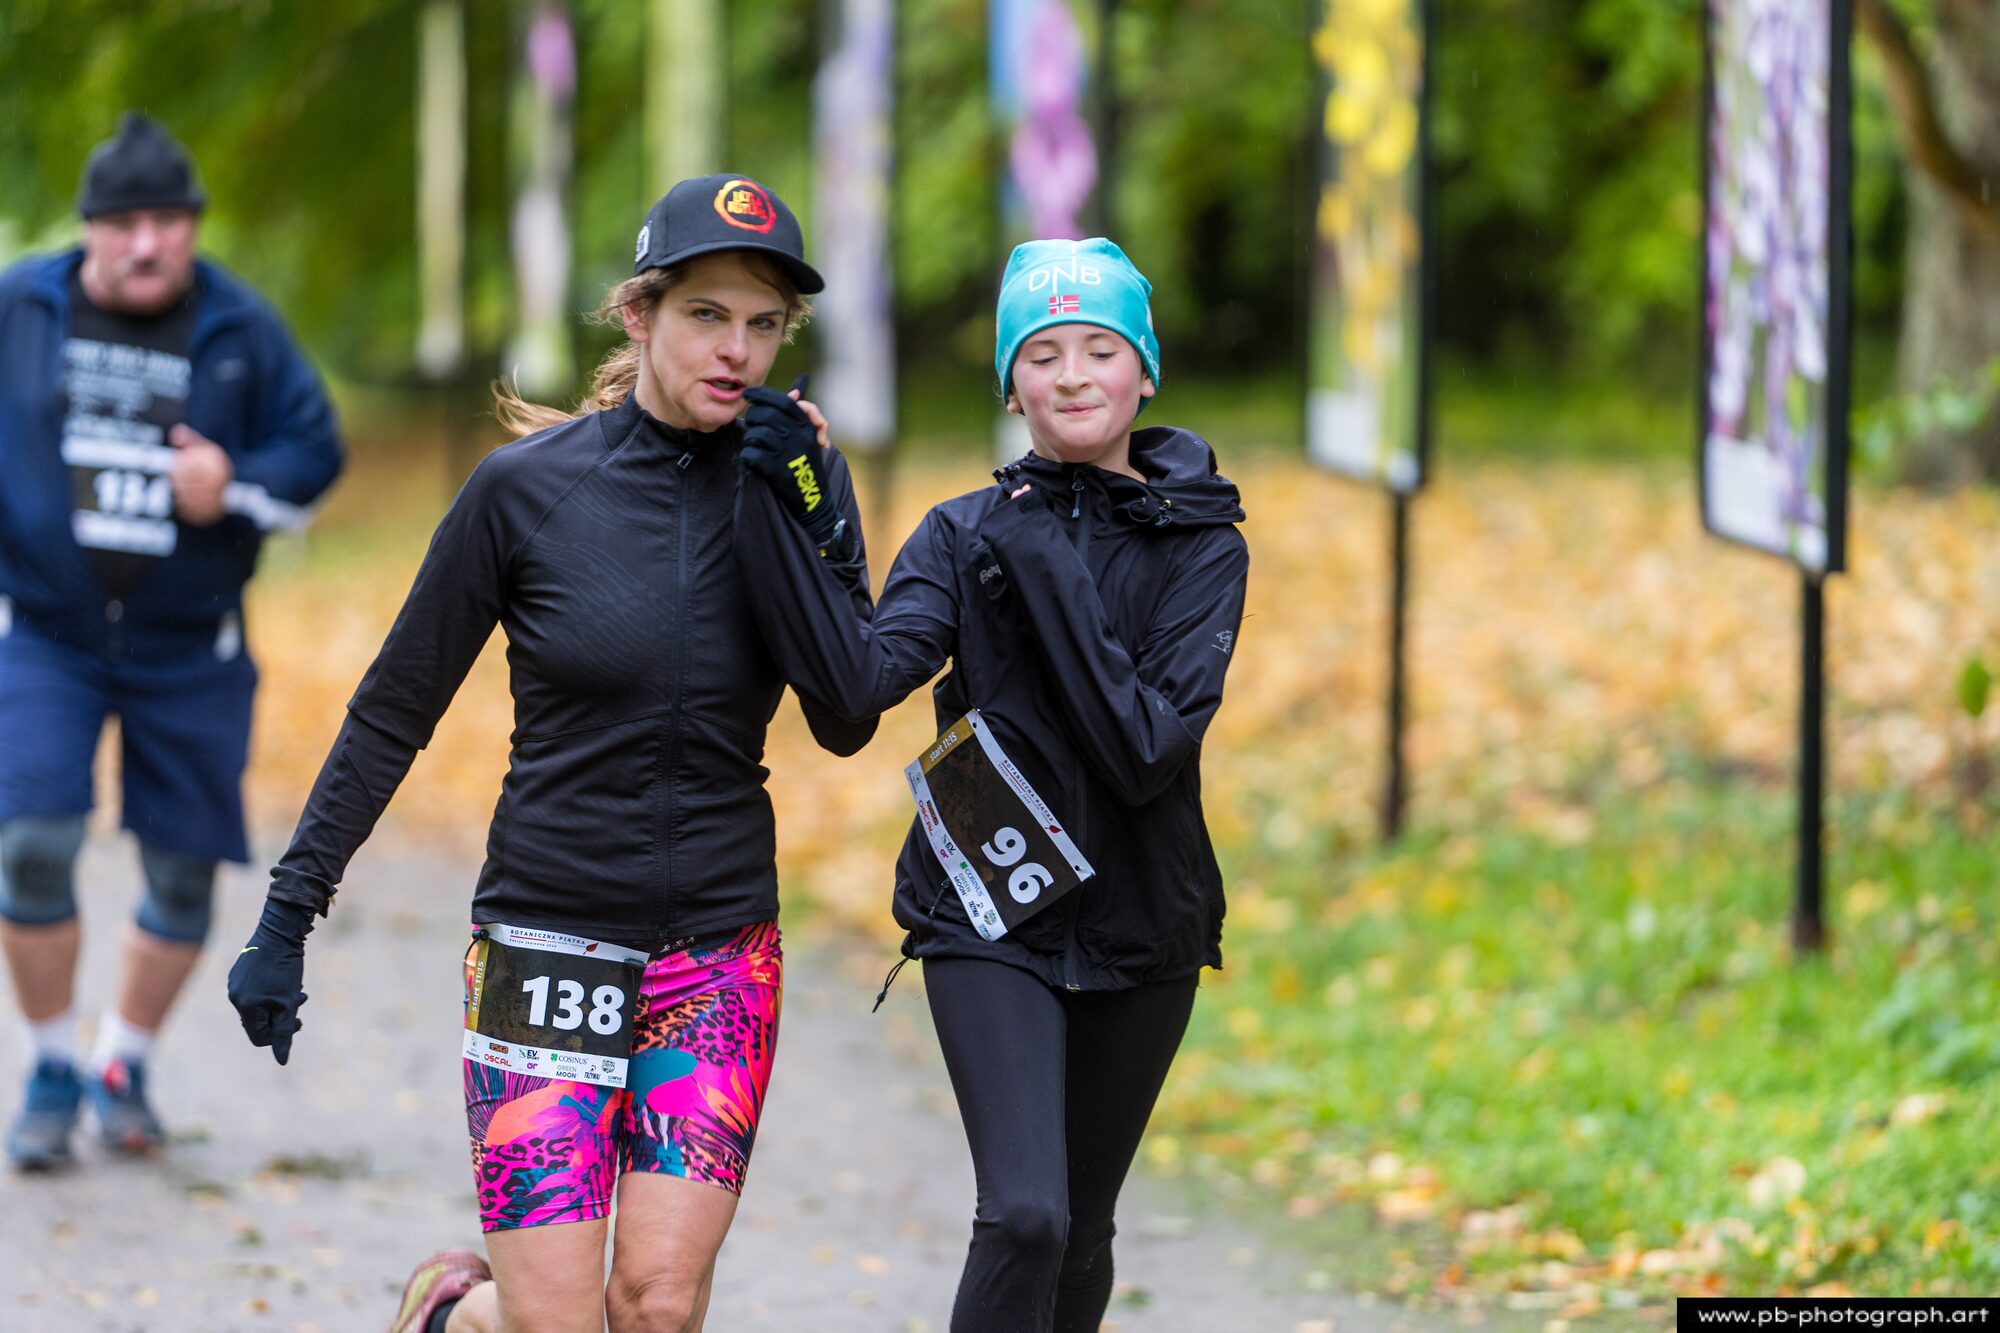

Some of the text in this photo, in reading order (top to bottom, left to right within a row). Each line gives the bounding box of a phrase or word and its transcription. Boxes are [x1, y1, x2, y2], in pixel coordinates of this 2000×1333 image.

[1028, 255, 1102, 293] DNB
[787, 454, 822, 512] HOKA
[930, 731, 957, 761] start 11:15
[919, 800, 934, 836] OSCAL
[981, 826, 1054, 904] 96
[953, 875, 967, 896] MOON
[958, 872, 972, 893] GREEN
[964, 868, 982, 898] COSINUS
[510, 929, 556, 940] BOTANICZNA
[471, 987, 480, 1012] start
[522, 976, 625, 1035] 138
[484, 1053, 512, 1067] OSCAL
[527, 1049, 538, 1057] EV
[558, 1055, 588, 1065] COSINUS
[557, 1064, 577, 1072] GREEN
